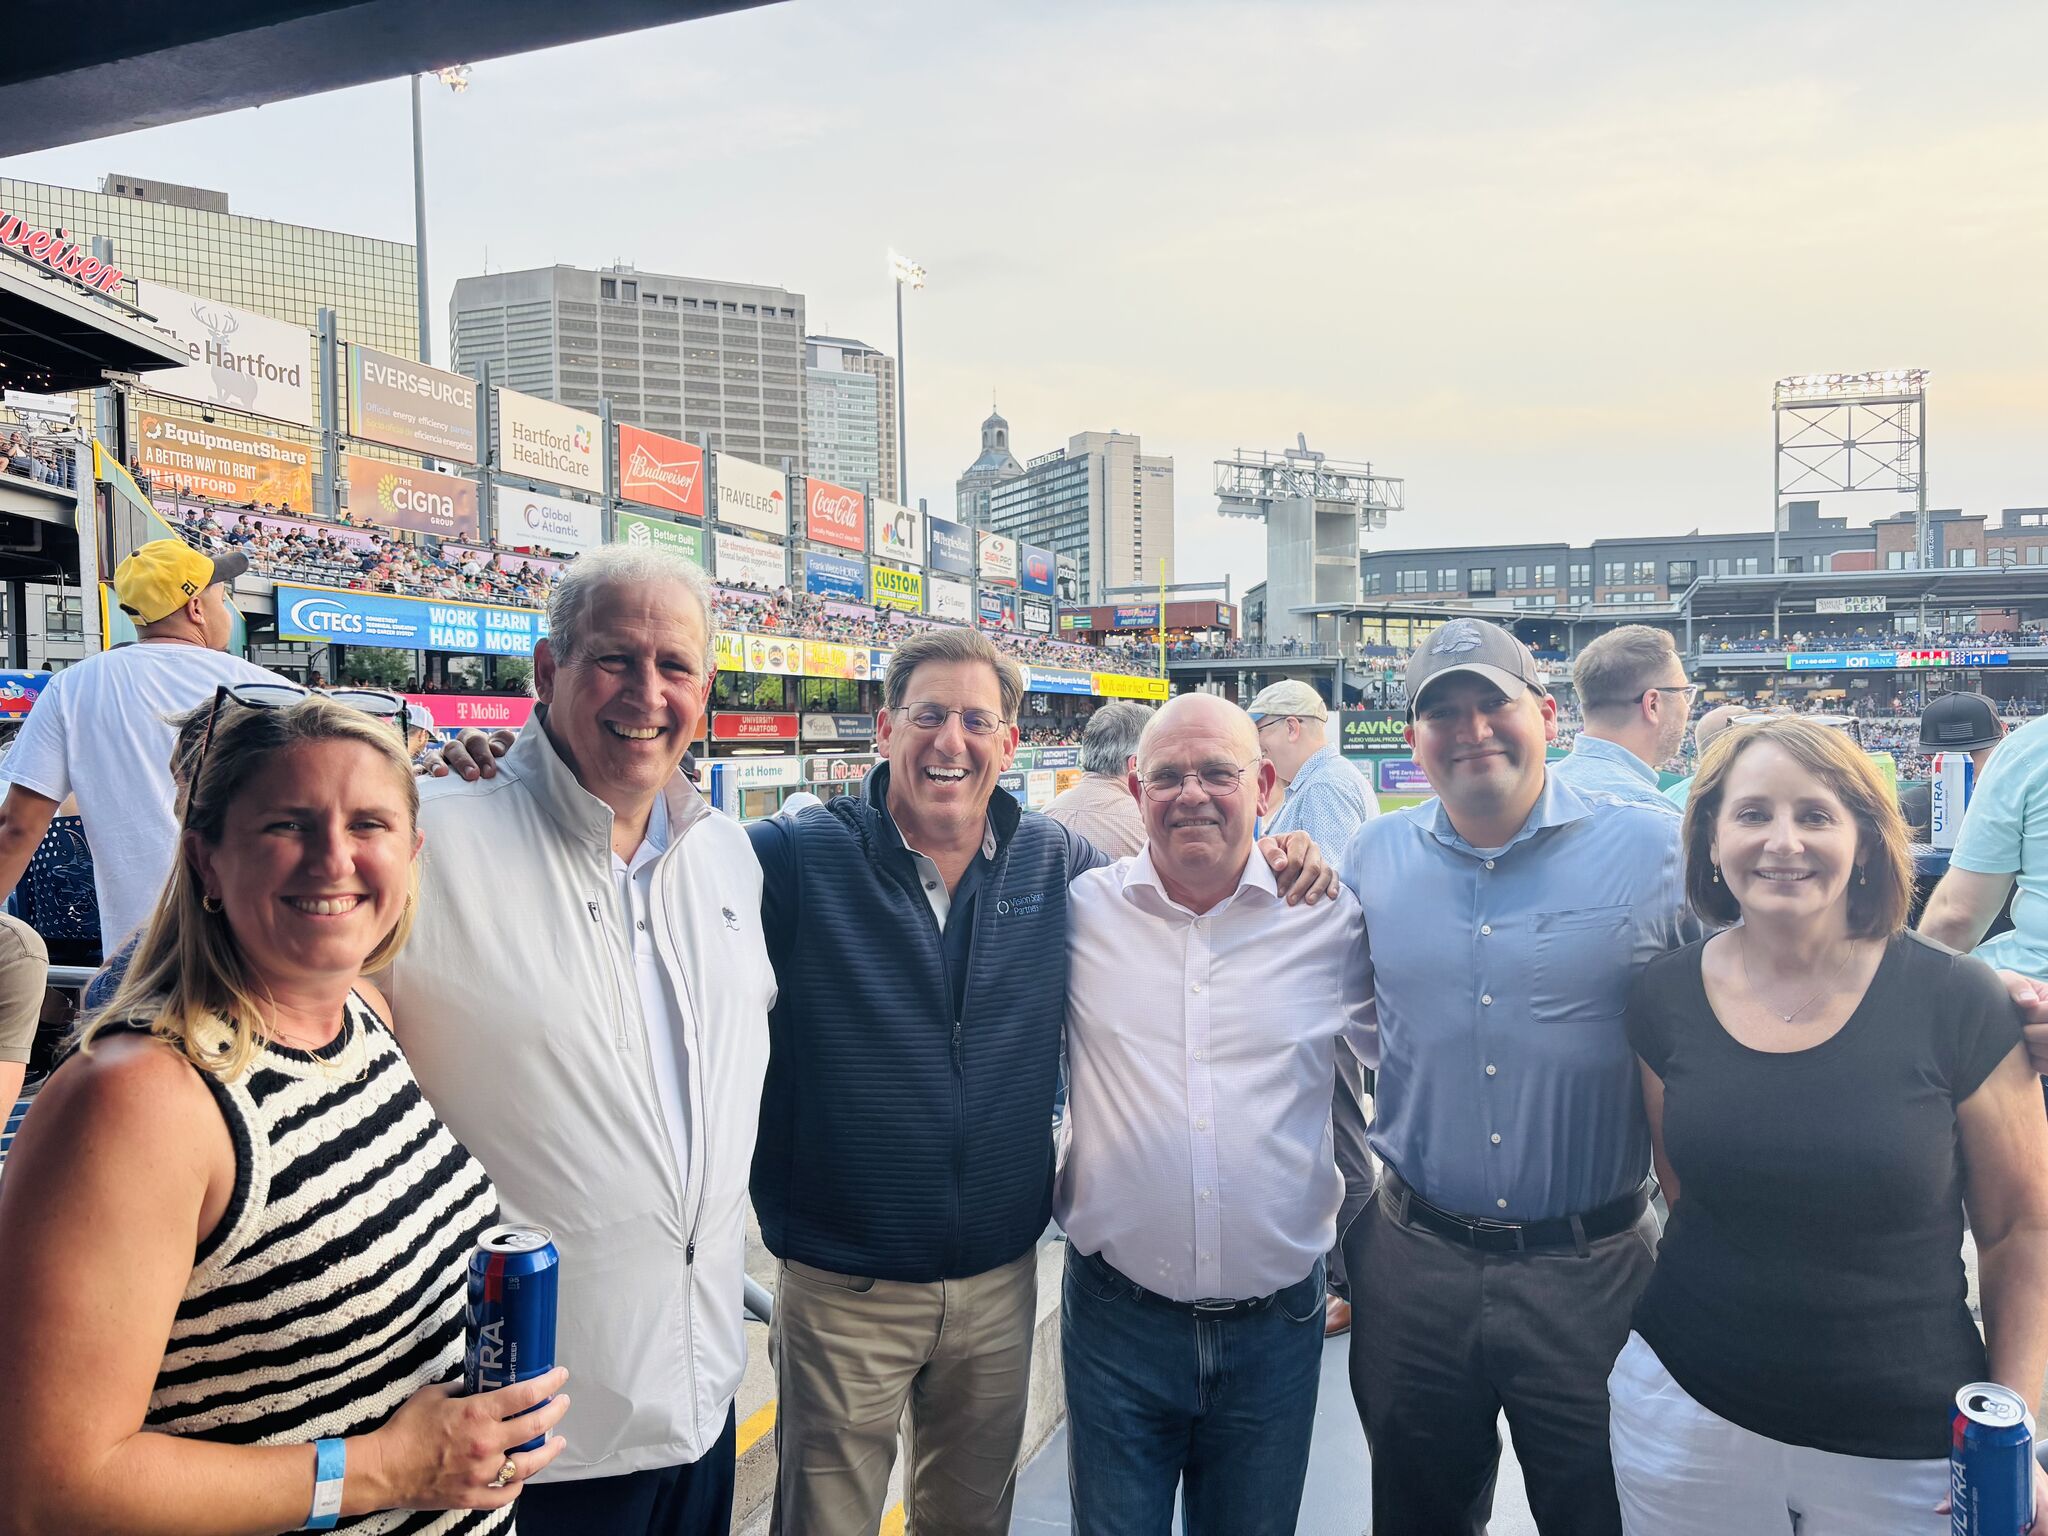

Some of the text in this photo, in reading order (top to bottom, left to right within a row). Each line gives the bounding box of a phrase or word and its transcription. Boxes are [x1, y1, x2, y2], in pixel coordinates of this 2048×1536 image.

[205, 339, 301, 388] Hartford
[364, 360, 473, 410] EVERSOURCE
[393, 410, 416, 425] energy
[418, 416, 449, 432] efficiency
[164, 422, 306, 465] EquipmentShare
[414, 430, 442, 444] eficiencia
[512, 421, 571, 452] Hartford
[146, 447, 257, 481] A BETTER WAY TO RENT
[512, 443, 589, 477] HealthCare
[630, 450, 694, 489] Budweiser
[145, 468, 237, 494] IN HARTFORD
[398, 477, 412, 487] THE
[719, 485, 773, 514] TRAVELERS
[812, 488, 860, 529] Coca-Cola
[430, 516, 454, 527] GROUP
[541, 506, 572, 522] Global
[542, 519, 579, 538] Atlantic
[653, 528, 694, 546] Better Built
[894, 510, 916, 549] CT
[809, 559, 825, 571] Frank
[876, 570, 919, 594] CUSTOM
[1844, 596, 1884, 604] PARTY
[1845, 604, 1884, 612] DECK!
[308, 610, 362, 633] CTECS
[430, 607, 478, 627] WORK
[486, 612, 531, 631] LEARN
[430, 627, 531, 652] HARD MORE
[714, 635, 733, 654] DAY
[1846, 656, 1869, 667] ion
[470, 703, 510, 720] Mobile
[741, 716, 775, 724] UNIVERSITY
[739, 725, 778, 734] OF HARTFORD
[1344, 718, 1405, 734] 4AVNO
[745, 766, 754, 776] at
[756, 764, 783, 776] Home
[1933, 780, 1943, 832] ULTRA
[510, 1342, 518, 1362] BEER
